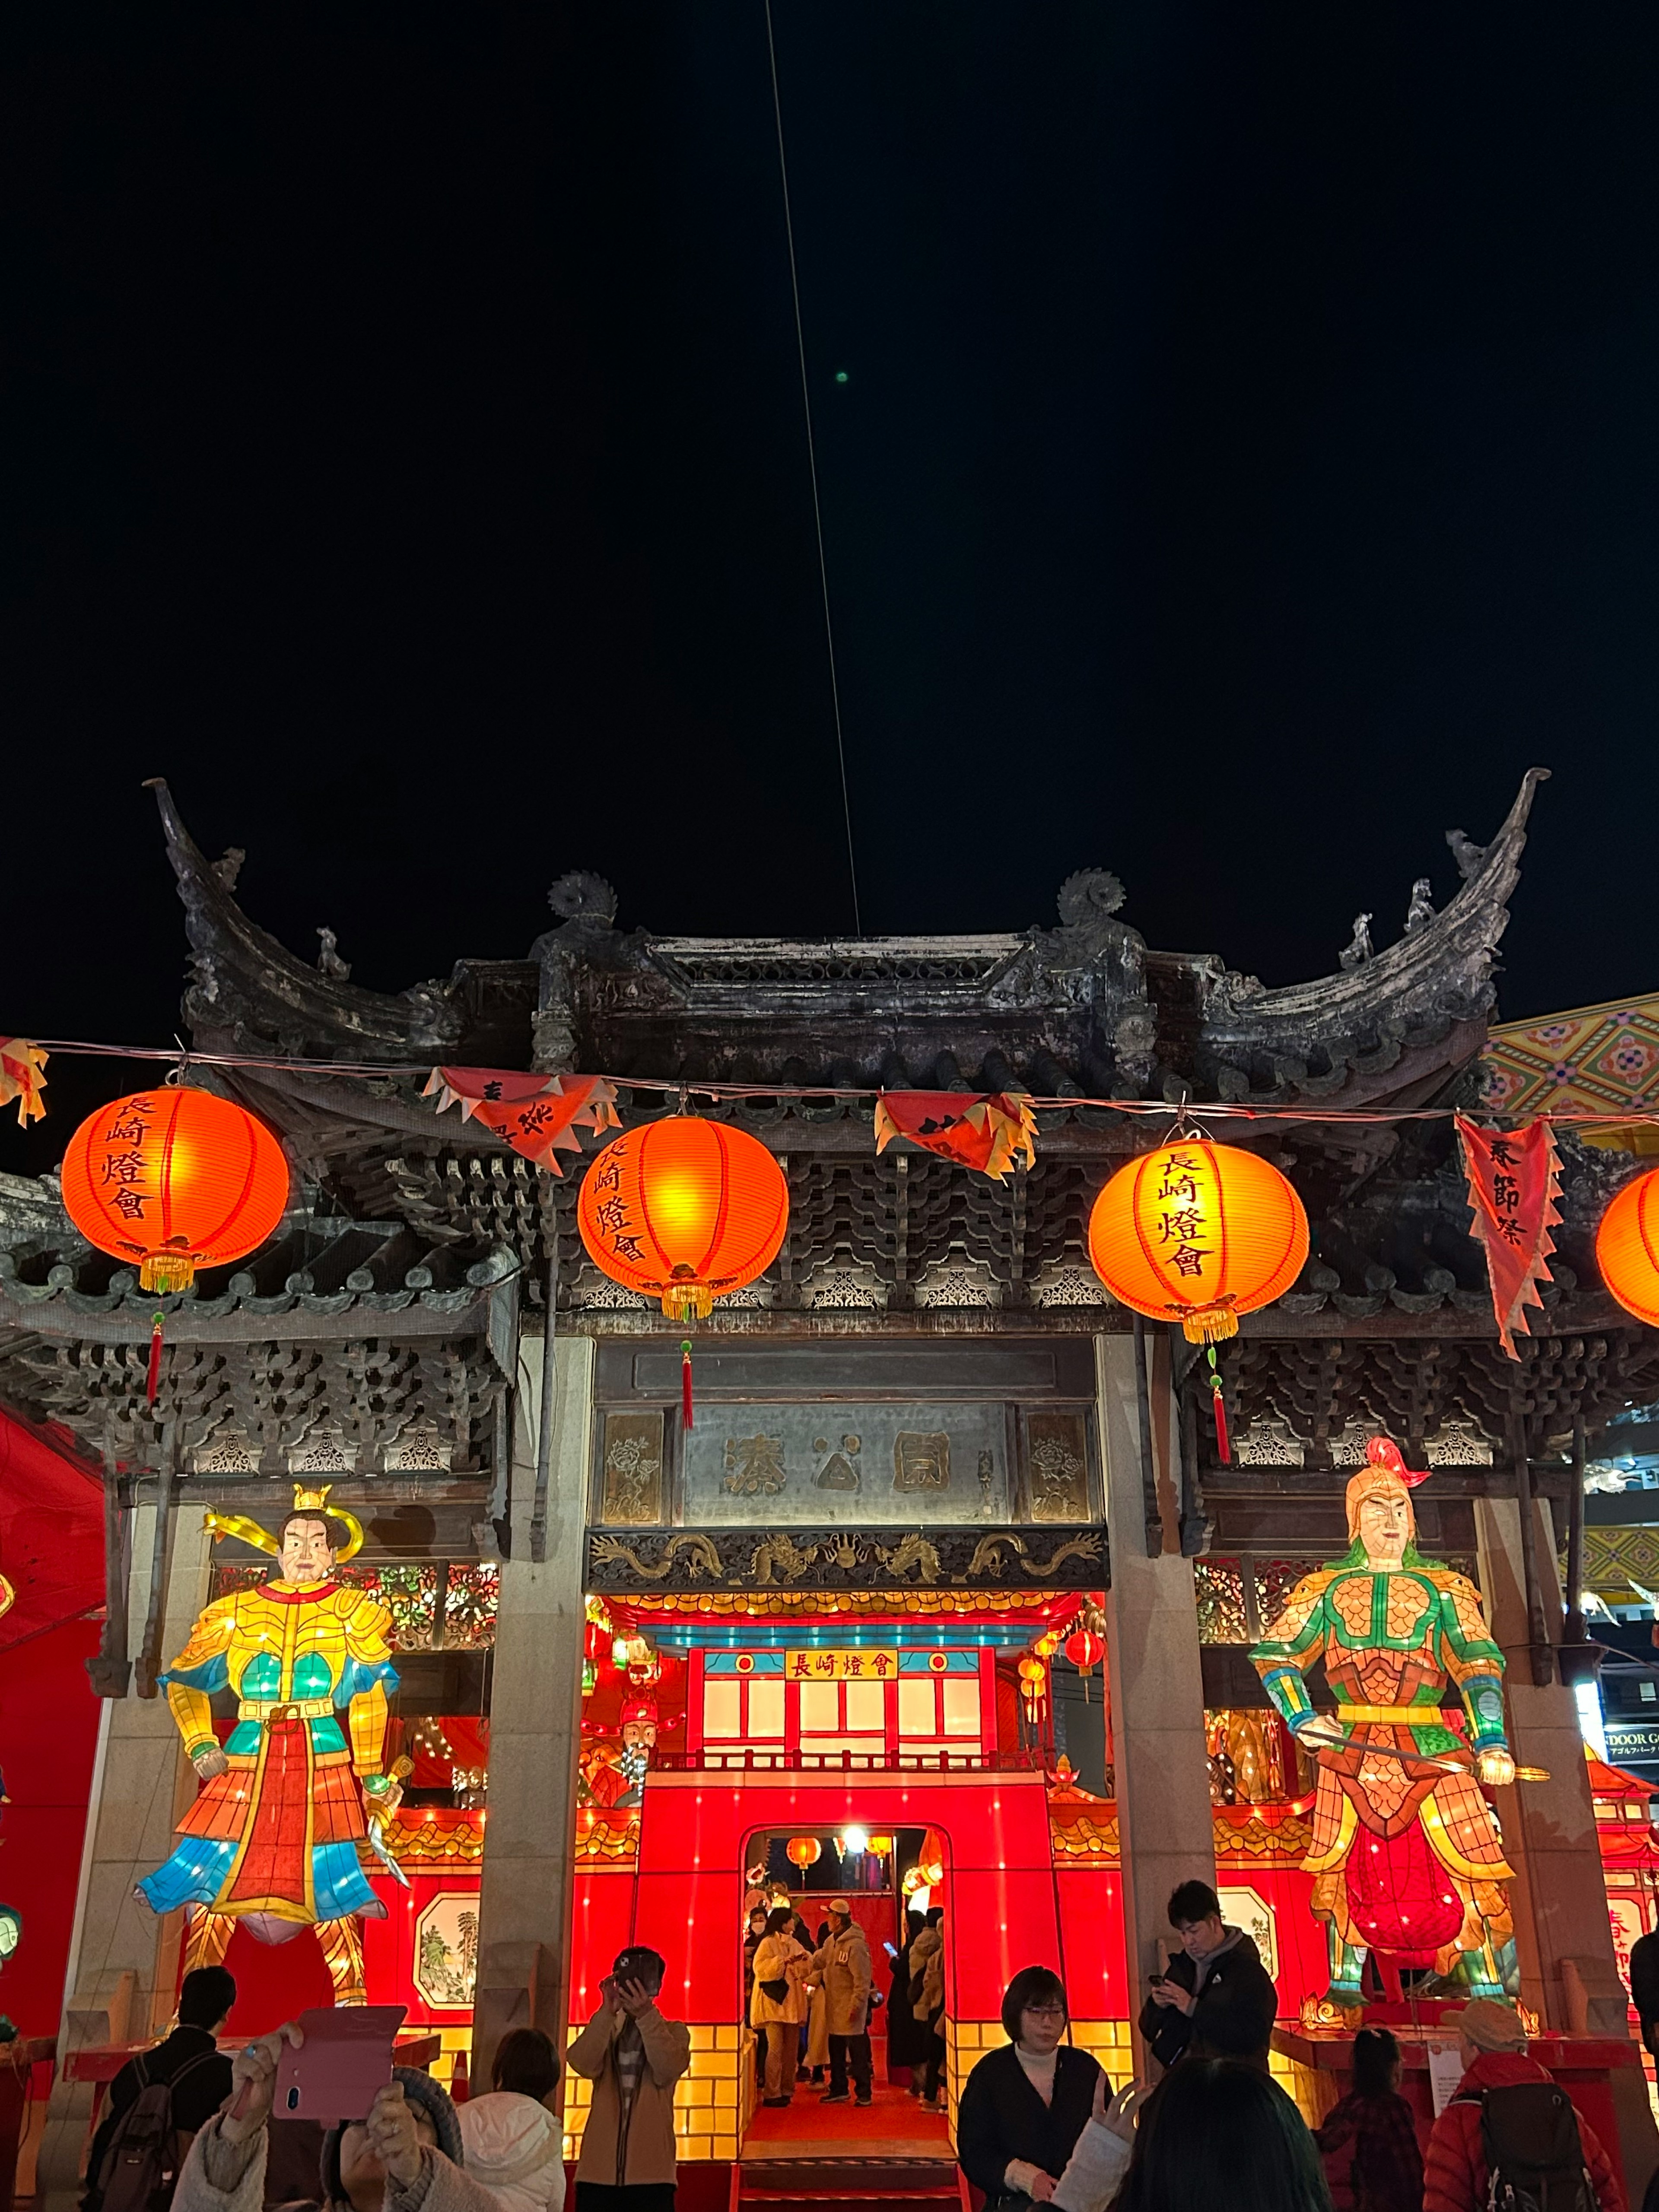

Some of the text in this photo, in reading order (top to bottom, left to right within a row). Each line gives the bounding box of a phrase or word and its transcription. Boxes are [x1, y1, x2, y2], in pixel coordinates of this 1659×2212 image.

[101, 1096, 158, 1220] 長崎燈會
[593, 1136, 646, 1262] 長崎燈會
[1490, 1140, 1528, 1246] 春節祭
[1157, 1152, 1215, 1277] 長崎燈會
[724, 1432, 950, 1493] 湊公園
[791, 1653, 894, 1677] 長崎燈會
[1649, 1733, 1659, 1744] G
